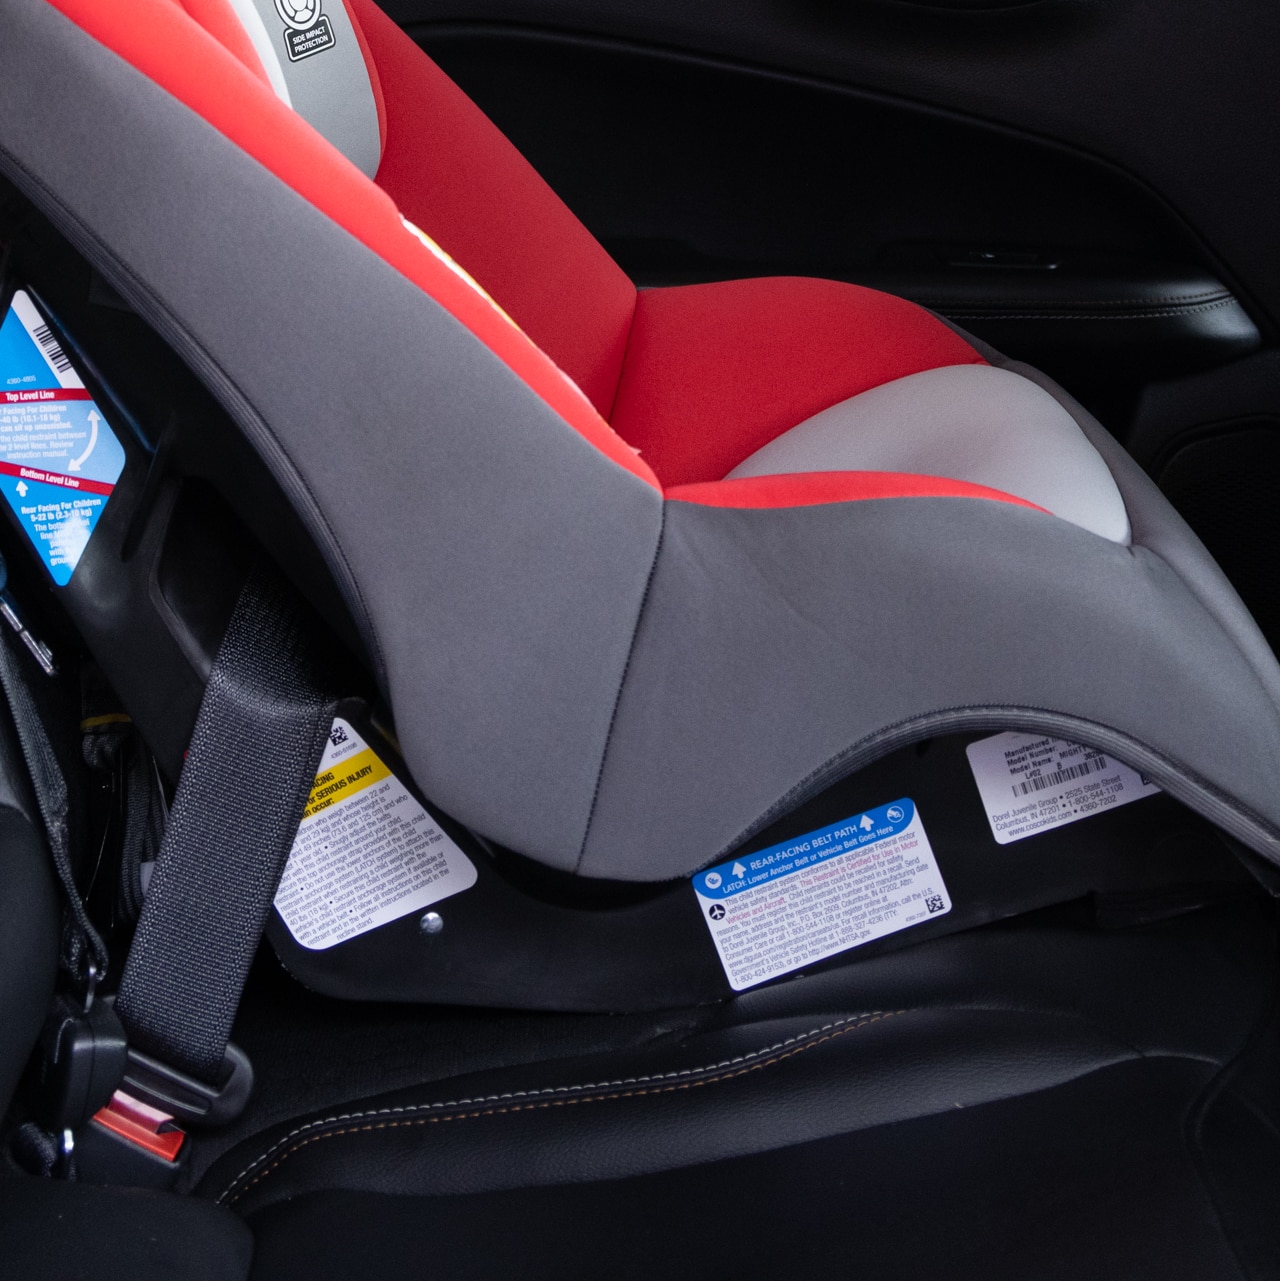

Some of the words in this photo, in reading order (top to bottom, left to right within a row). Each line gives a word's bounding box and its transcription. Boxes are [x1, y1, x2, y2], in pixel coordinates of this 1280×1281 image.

[293, 34, 305, 44] SIDE
[306, 26, 325, 39] IMPACT
[295, 35, 328, 53] PROTECTION
[5, 392, 19, 402] Top
[19, 391, 39, 400] Level
[39, 391, 55, 399] Line
[2, 407, 26, 415] Facing
[38, 404, 67, 413] Children
[11, 415, 19, 423] lb
[48, 413, 61, 422] kg)
[20, 467, 45, 480] Bottom
[45, 473, 64, 484] Level
[64, 477, 79, 488] Line
[20, 506, 37, 514] Rear
[37, 503, 60, 512] Facing
[60, 501, 72, 510] For
[72, 498, 101, 509] Children
[30, 512, 47, 522] 5-22
[47, 511, 55, 520] lb
[79, 507, 92, 516] kg)
[1004, 737, 1049, 758] Manufactured
[1007, 753, 1028, 766] Model
[1028, 745, 1059, 759] Number:
[1009, 762, 1031, 774] Model
[1031, 757, 1055, 768] Name:
[1058, 743, 1087, 759] MIGHTY
[306, 796, 316, 804] or
[315, 778, 347, 800] SERIOUS
[346, 764, 372, 784] INJURY
[311, 797, 334, 813] occur:
[992, 810, 1010, 823] Dorel
[1011, 803, 1037, 817] Juvenile
[1037, 796, 1058, 808] Group
[1064, 787, 1083, 799] 2525
[1082, 782, 1101, 793] State
[1100, 774, 1121, 787] Street
[995, 815, 1030, 831] Columbus,
[1029, 811, 1038, 820] IN
[1039, 804, 1060, 816] 47201
[1067, 782, 1124, 807] 1-800-544-1108
[1007, 810, 1072, 836] www.coscokids.com
[1079, 794, 1117, 812] 4360-7202
[750, 842, 810, 870] REAR-FACING
[811, 833, 832, 848] BELT
[834, 824, 857, 839] PATH
[722, 879, 747, 893] LATCH:
[747, 871, 768, 884] Lower
[770, 862, 793, 876] Anchor
[794, 856, 809, 867] Belt
[809, 853, 817, 861] or
[817, 844, 843, 858] Vehicle
[843, 838, 858, 848] Belt
[858, 832, 876, 843] Goes
[876, 825, 893, 836] Here
[336, 927, 356, 940] recline
[355, 917, 373, 930] stand.
[724, 945, 753, 961] Consumer
[753, 940, 768, 950] Care
[768, 937, 774, 945] or
[775, 932, 786, 942] call
[786, 914, 835, 937] 1-800-544-1108
[841, 904, 863, 916] register
[863, 898, 881, 909] online
[881, 895, 888, 903] at
